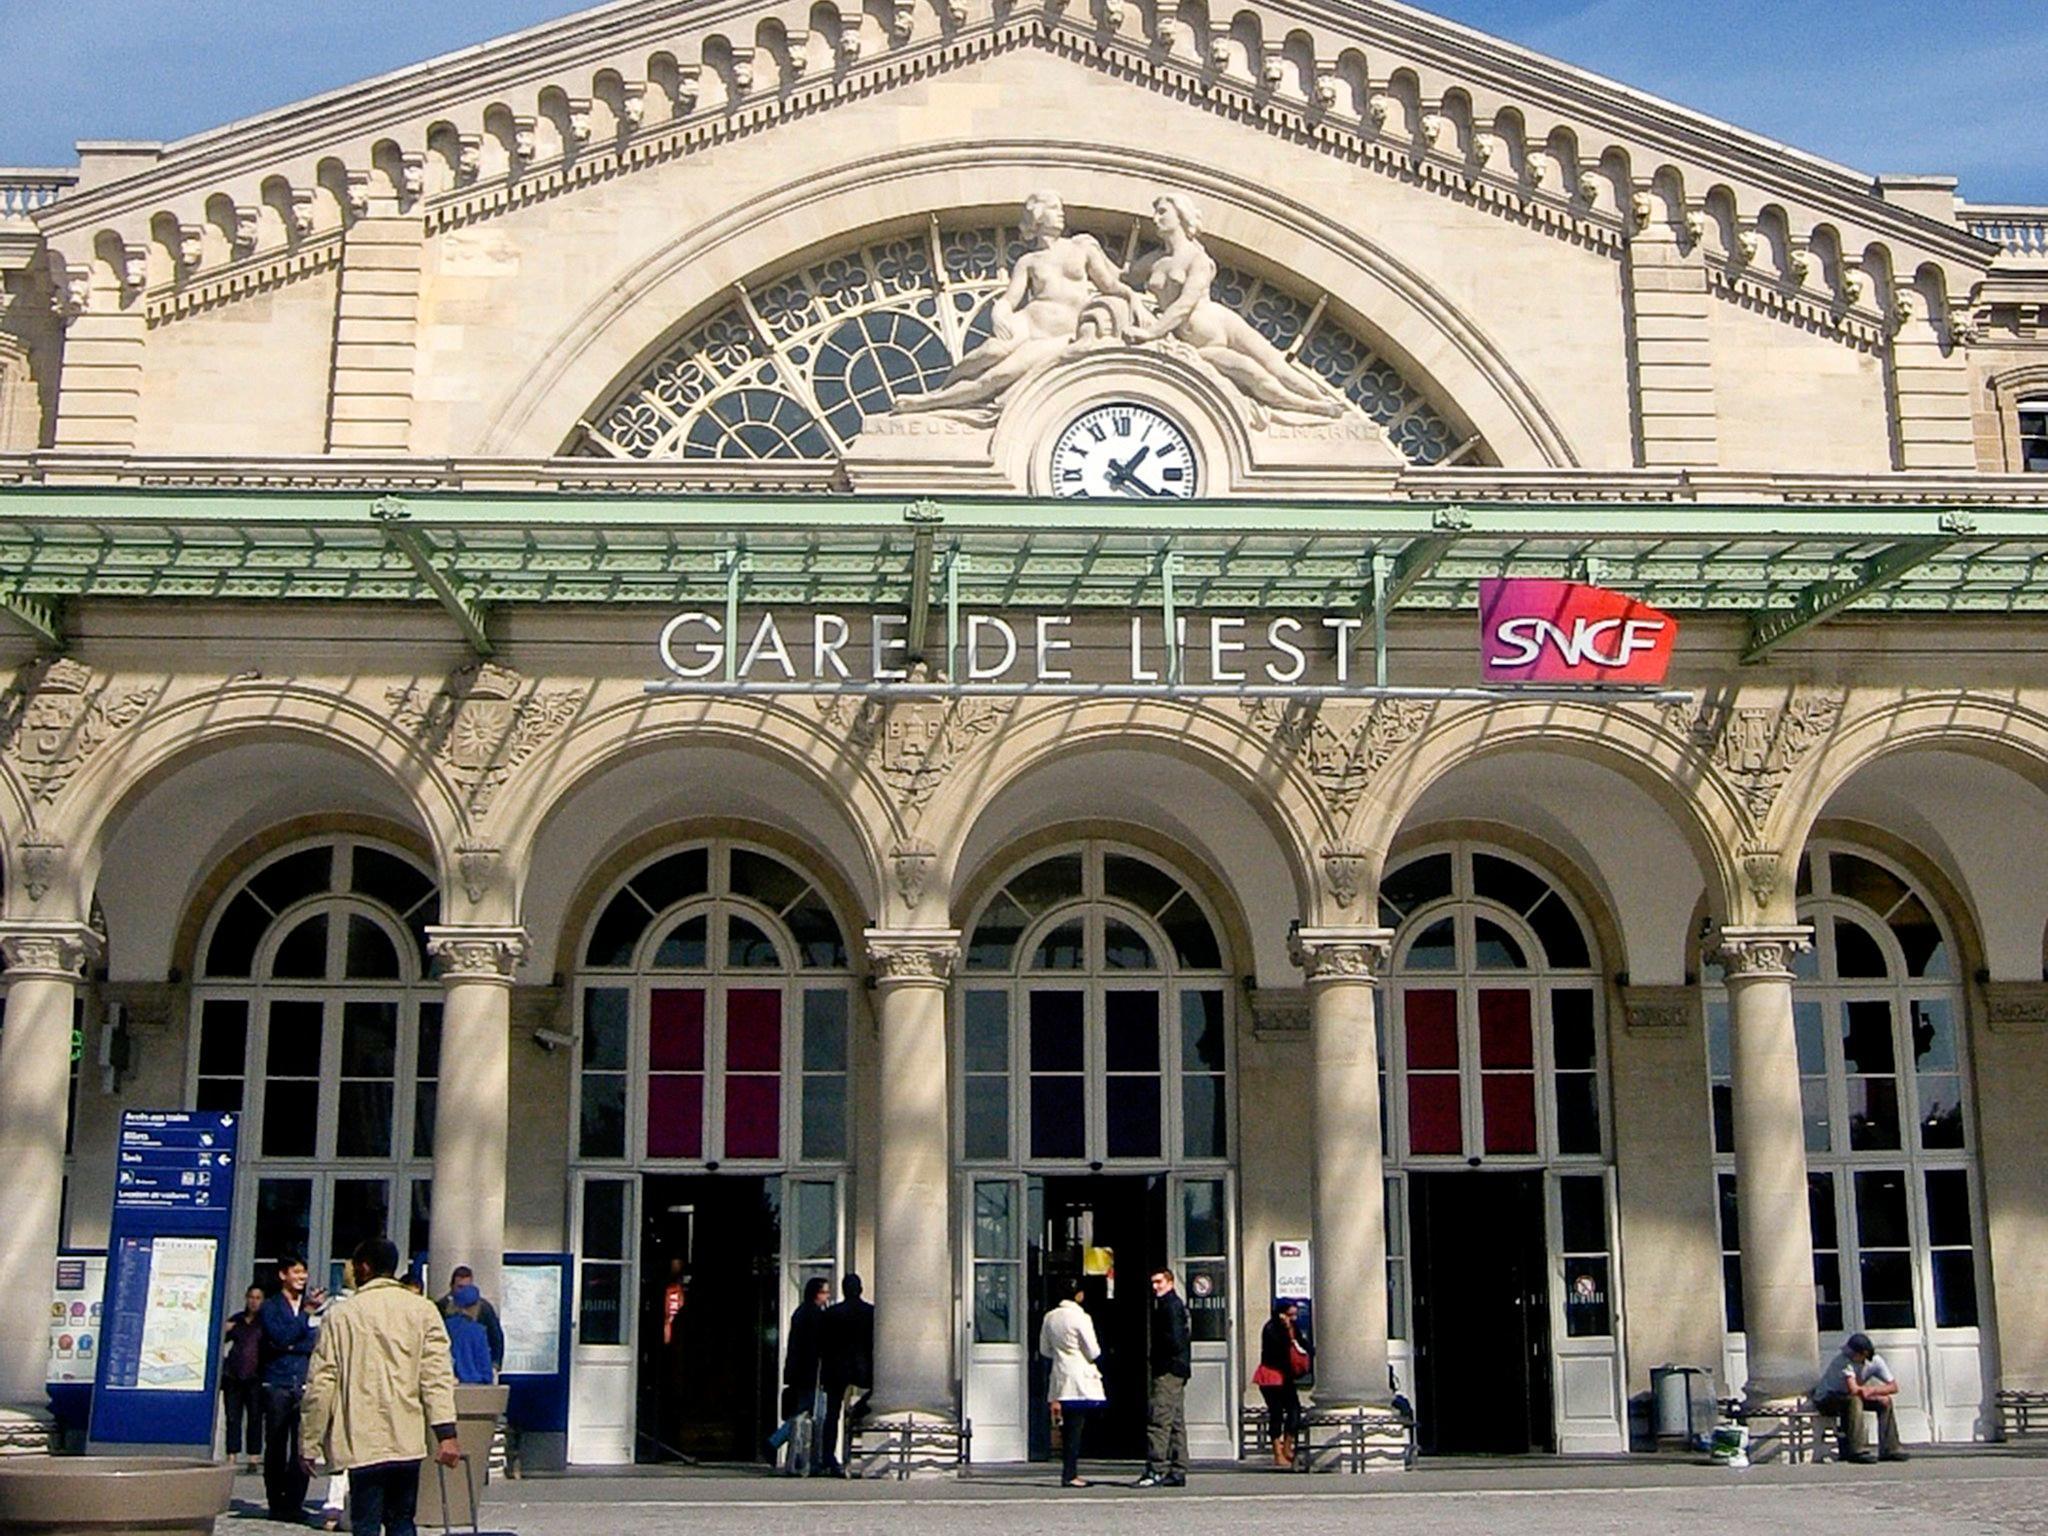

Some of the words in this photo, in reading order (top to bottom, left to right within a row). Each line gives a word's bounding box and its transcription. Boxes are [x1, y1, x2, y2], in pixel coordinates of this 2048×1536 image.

[660, 612, 907, 679] GARE
[967, 615, 1073, 679] DE
[1489, 617, 1665, 667] SNCF
